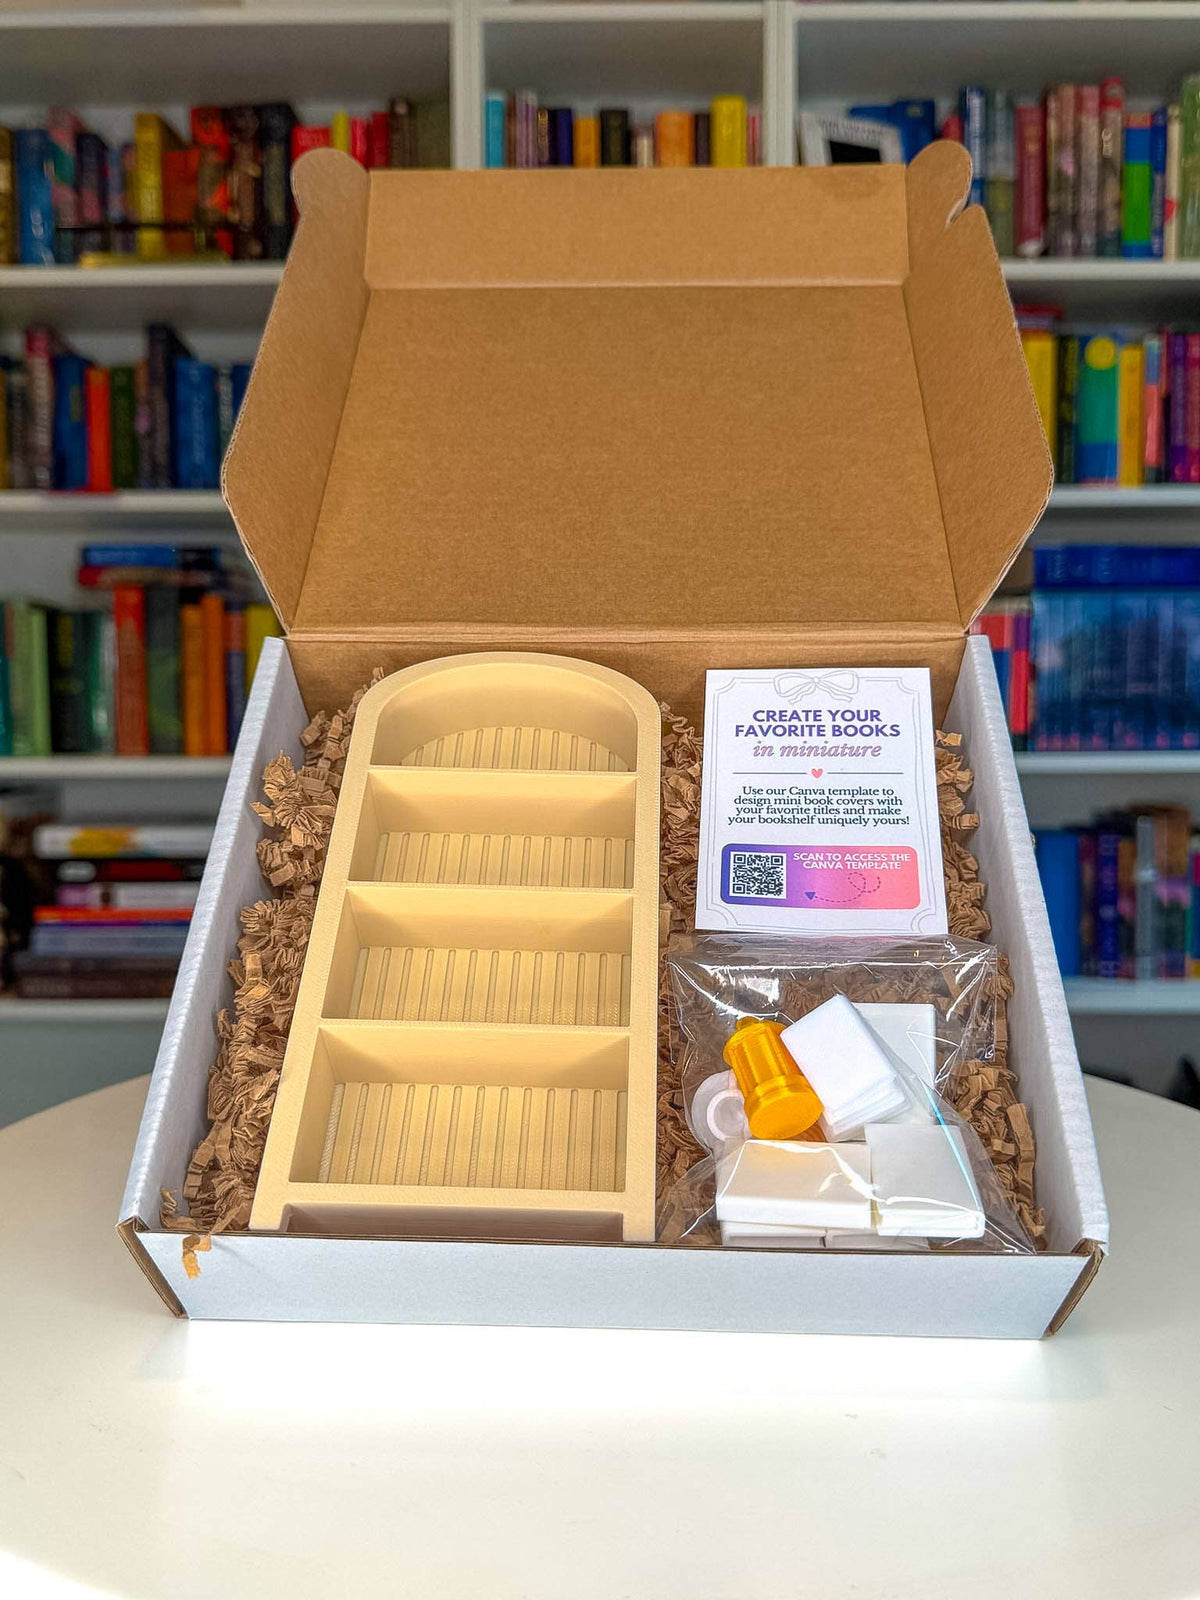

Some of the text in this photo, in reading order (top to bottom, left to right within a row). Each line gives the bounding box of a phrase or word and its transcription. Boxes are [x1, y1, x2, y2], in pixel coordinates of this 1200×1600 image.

[752, 709, 882, 722] CREATE YOUR
[735, 724, 901, 737] FAVORITE BOOKS
[753, 740, 882, 757] in miniature
[742, 786, 764, 795] Use
[789, 786, 825, 795] Canva
[828, 786, 880, 798] template
[882, 787, 894, 796] to
[733, 795, 771, 807] design
[774, 796, 802, 805] mini
[804, 796, 834, 805] book
[876, 796, 903, 805] with
[735, 805, 902, 816] your favorite titles and make
[727, 815, 910, 827] your bookshelf uniquely yours!
[793, 852, 911, 861] SCAN TO ACCESS THE
[802, 861, 901, 870] CANVA TEMPLATE
